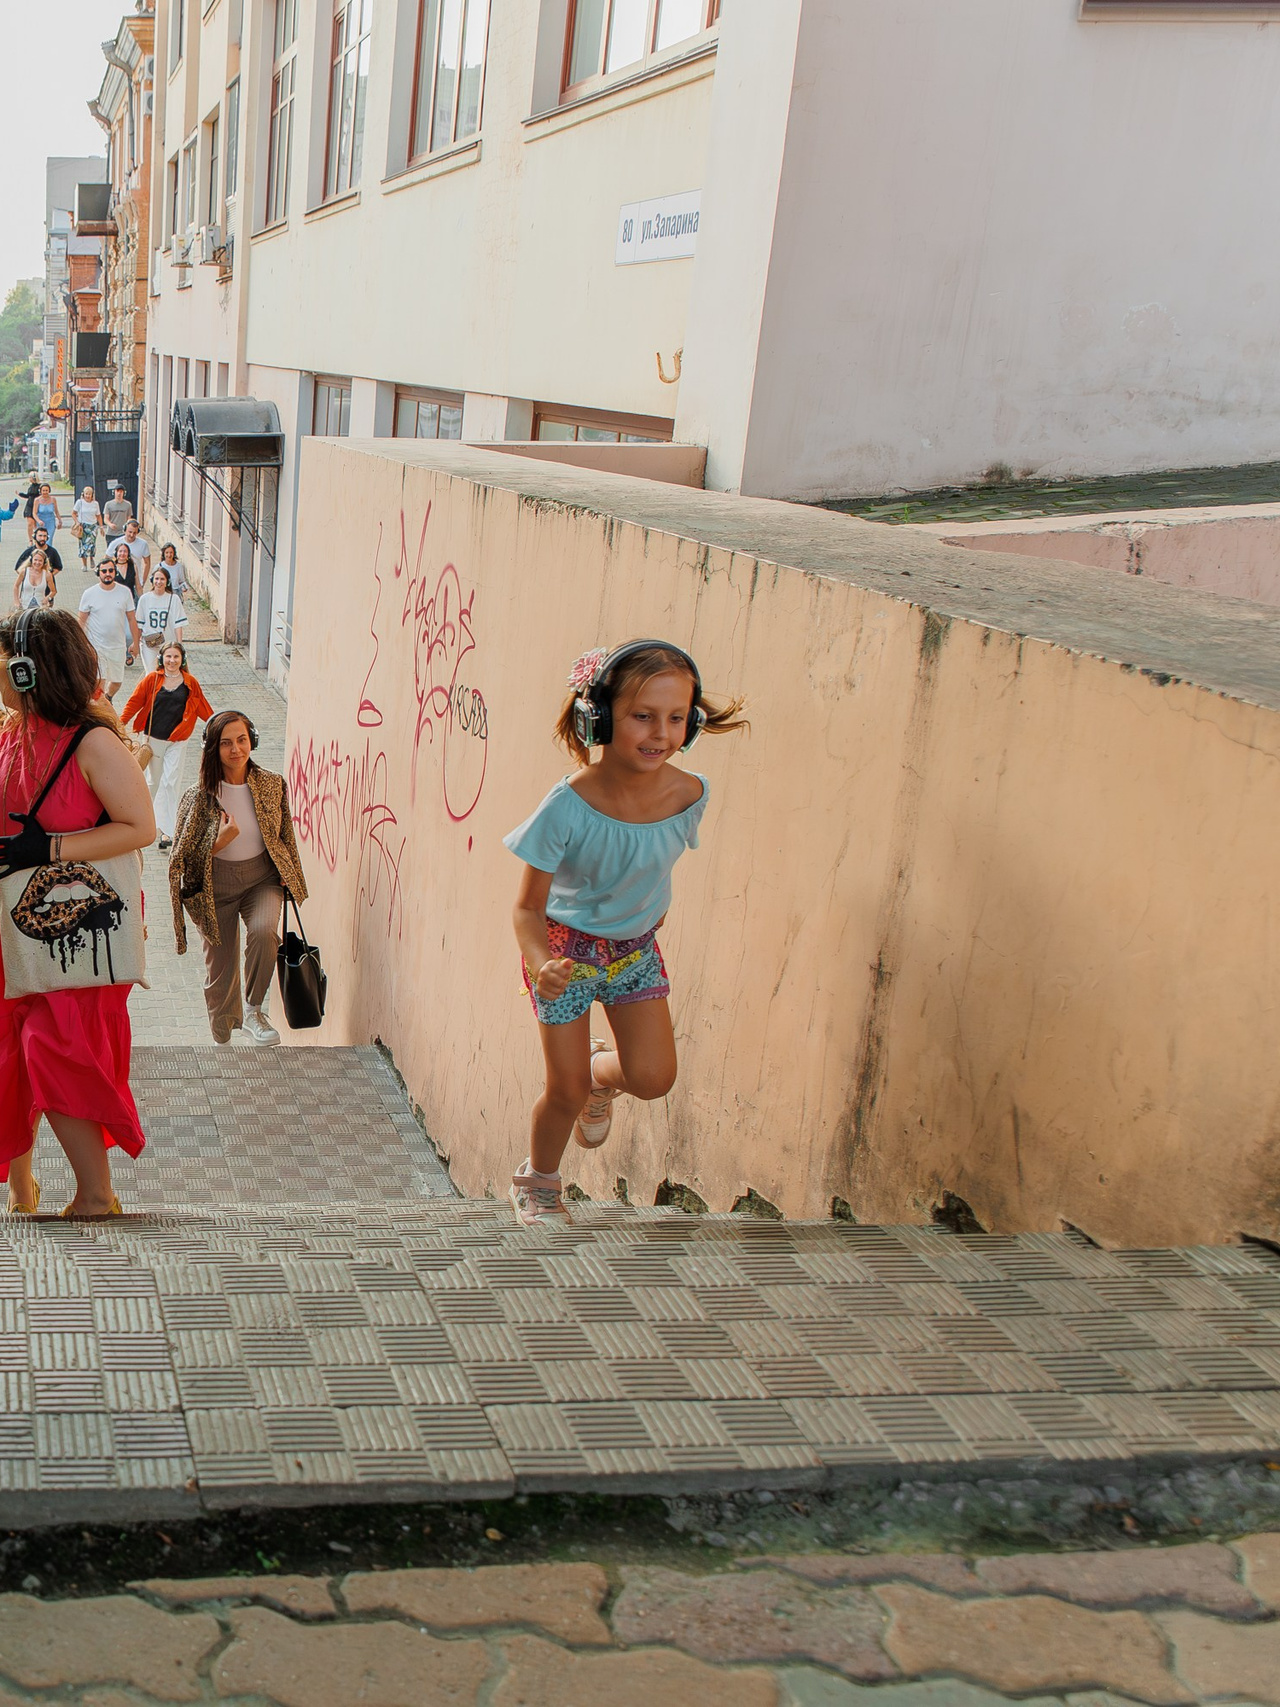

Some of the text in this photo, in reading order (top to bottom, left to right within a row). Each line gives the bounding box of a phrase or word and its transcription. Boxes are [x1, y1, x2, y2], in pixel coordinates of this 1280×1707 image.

[622, 218, 634, 244] 80
[641, 210, 700, 245] ул.Запарина
[149, 610, 169, 629] 68
